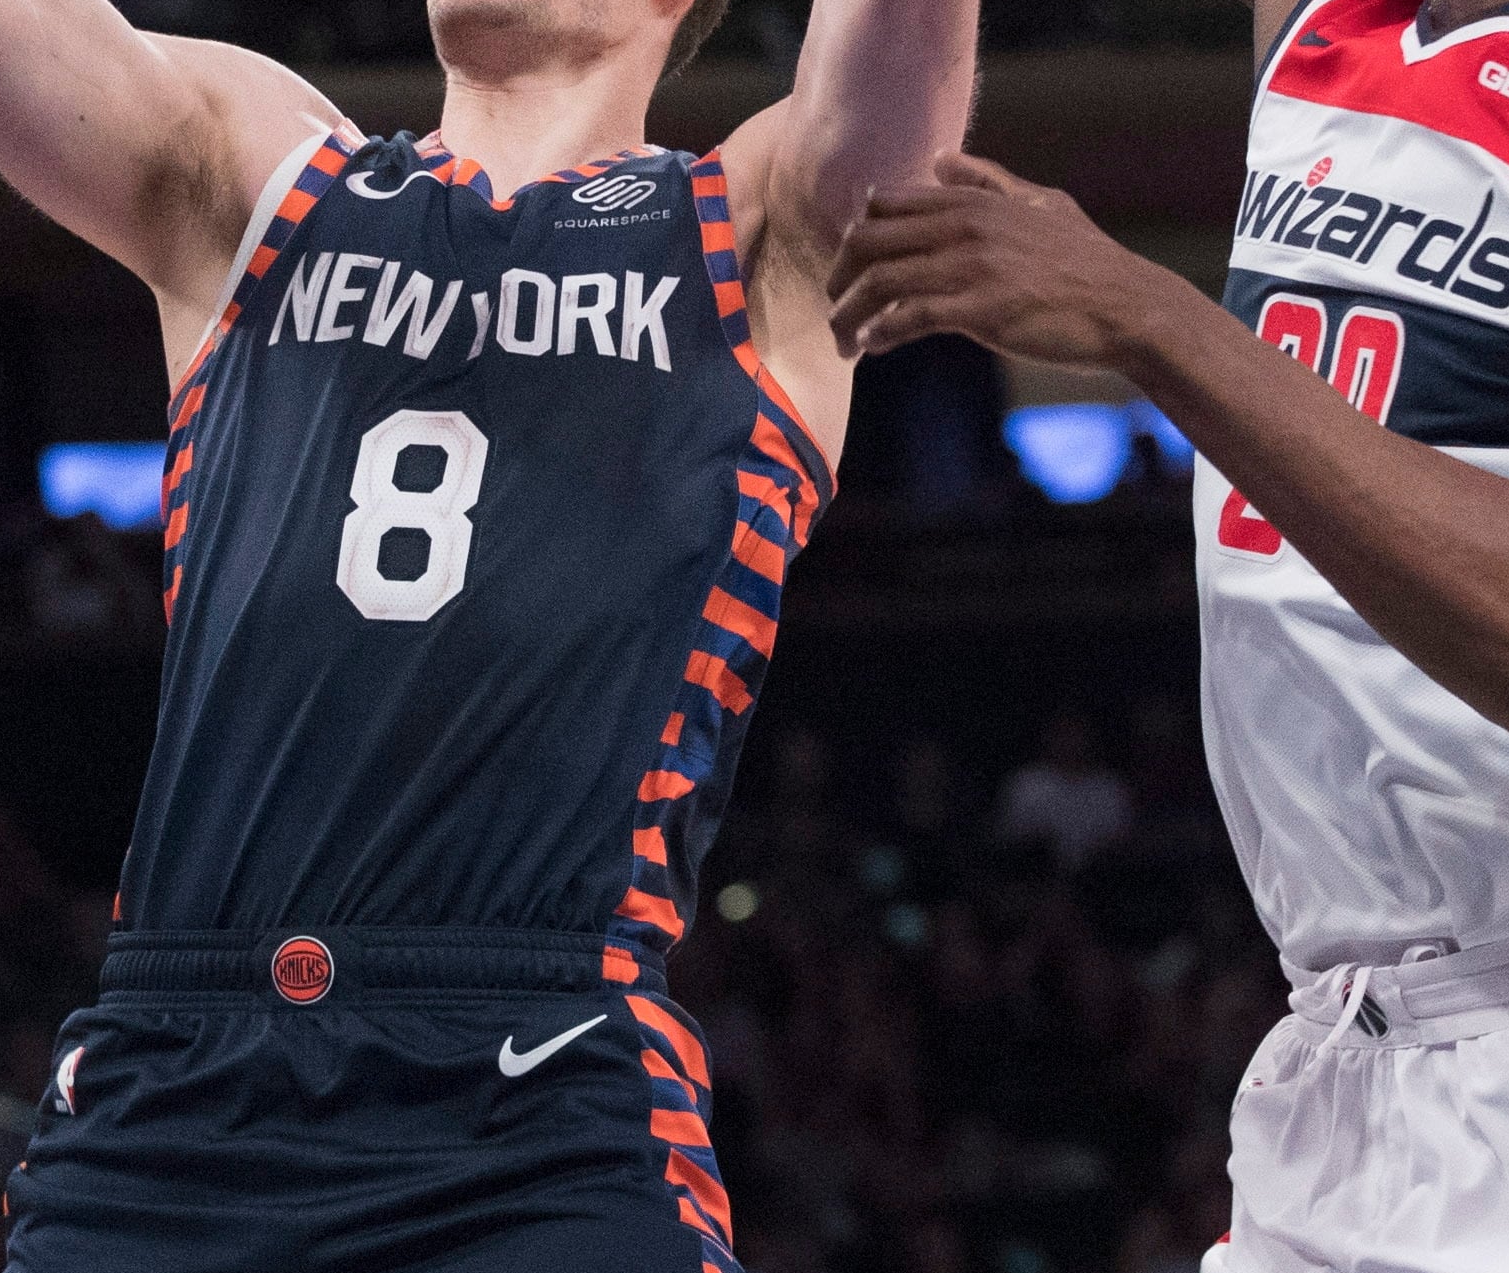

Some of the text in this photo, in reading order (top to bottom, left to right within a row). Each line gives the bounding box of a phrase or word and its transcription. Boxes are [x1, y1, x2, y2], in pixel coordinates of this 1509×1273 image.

[554, 209, 671, 229] SQUARESPACE
[268, 251, 464, 361] NEW
[335, 408, 489, 622] 8
[279, 956, 325, 985] KNICKS
